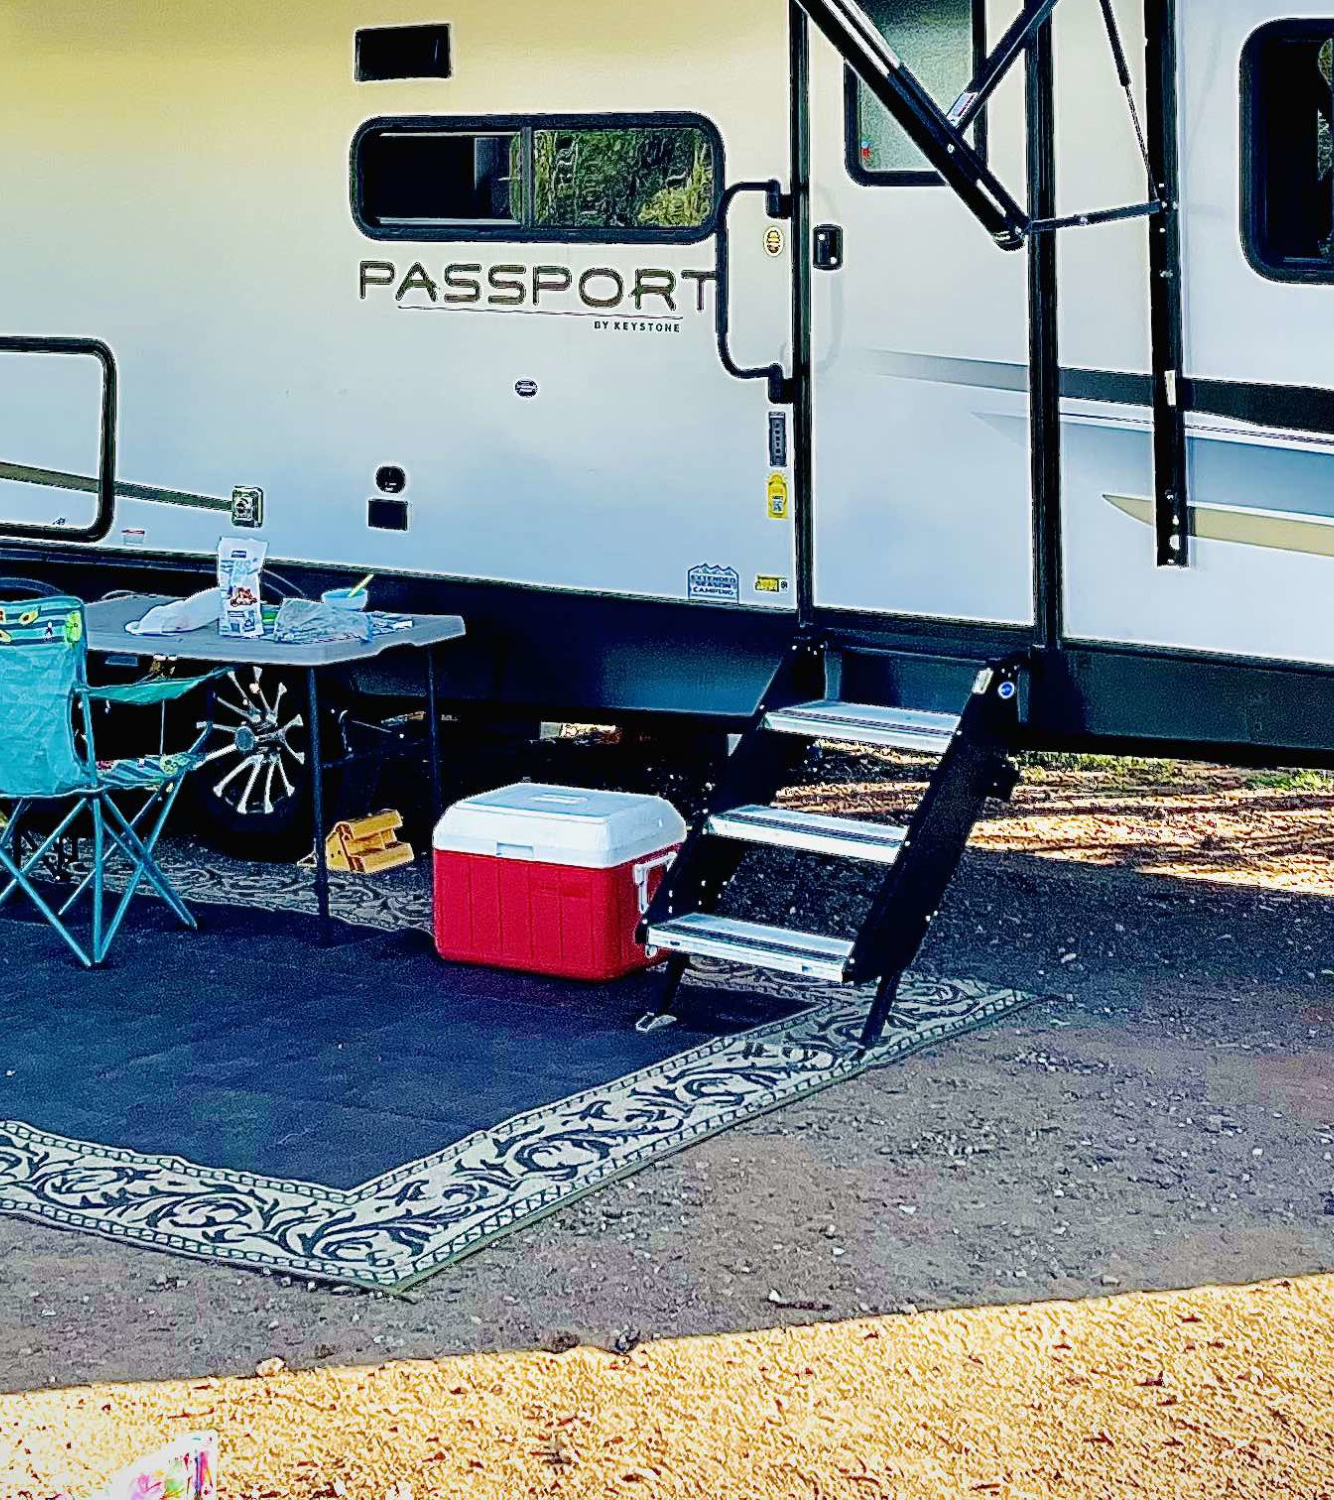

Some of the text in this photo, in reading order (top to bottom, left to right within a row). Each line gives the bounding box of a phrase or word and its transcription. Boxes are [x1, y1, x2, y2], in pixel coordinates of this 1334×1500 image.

[359, 260, 717, 311] PASSPORT
[594, 320, 680, 333] BY KEYSTONE
[693, 586, 734, 596] CAMPING
